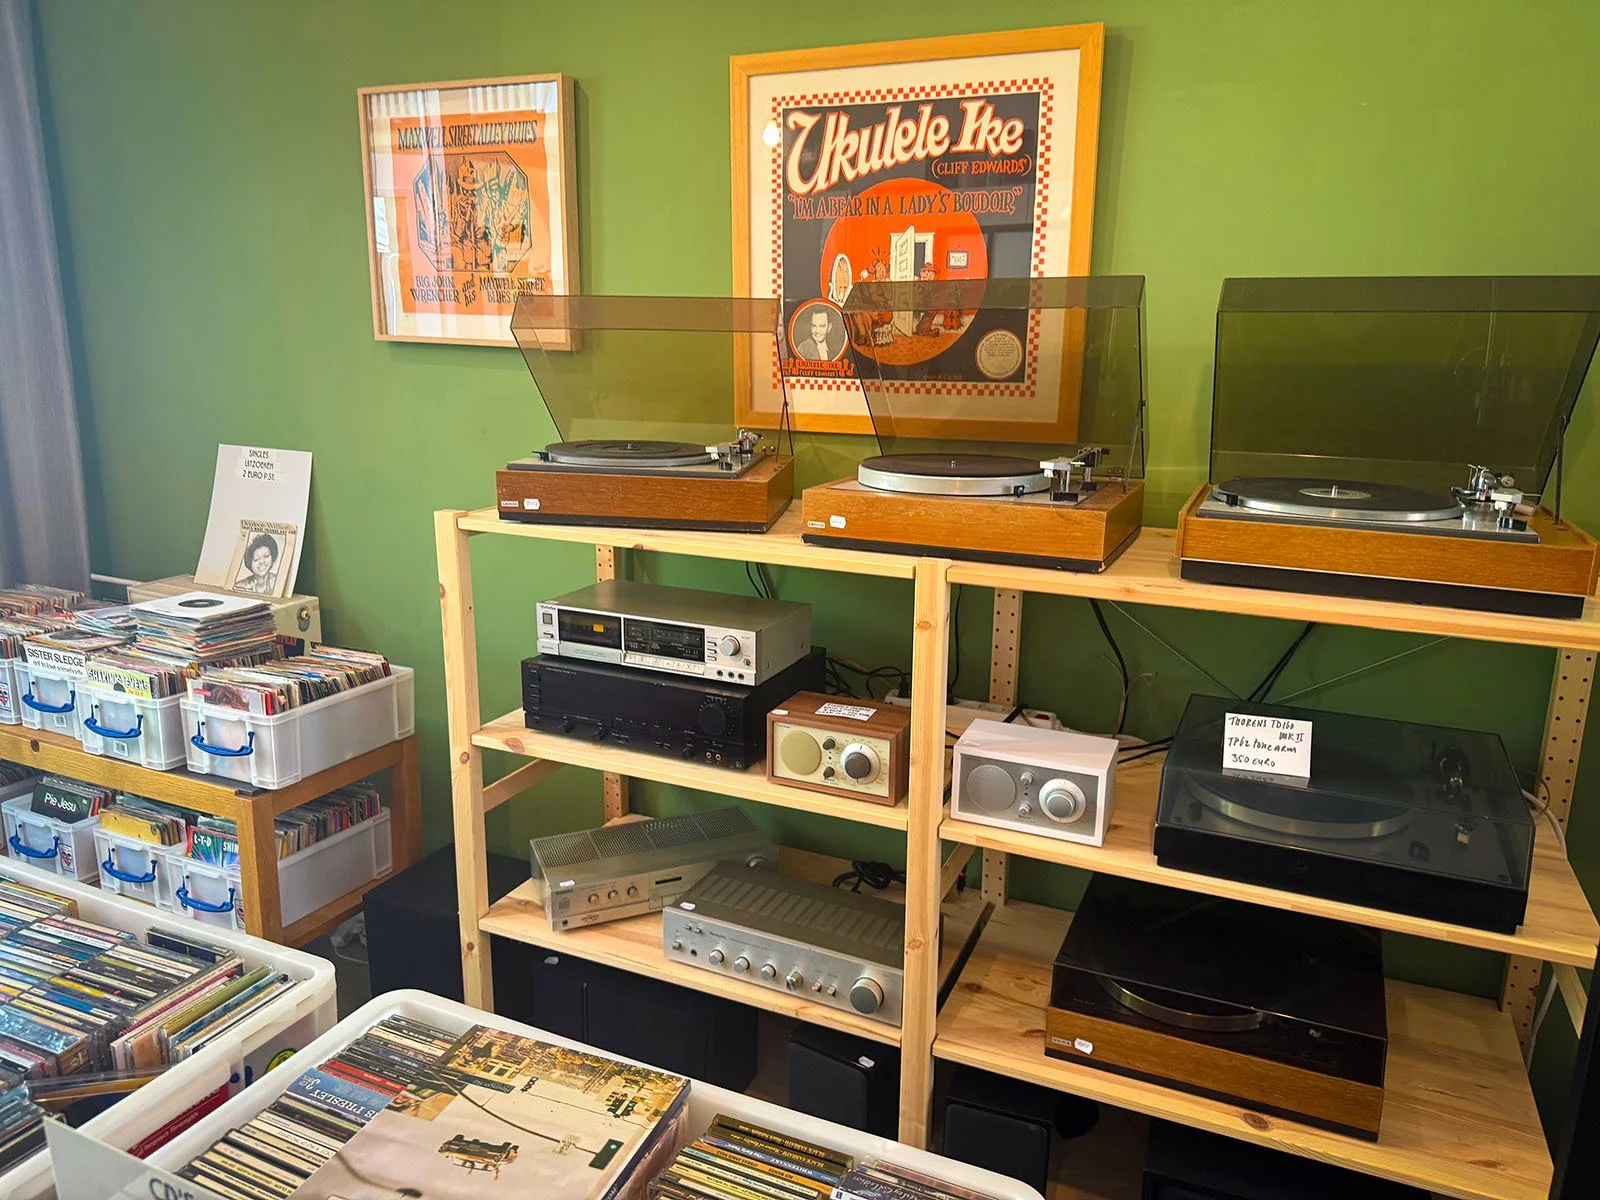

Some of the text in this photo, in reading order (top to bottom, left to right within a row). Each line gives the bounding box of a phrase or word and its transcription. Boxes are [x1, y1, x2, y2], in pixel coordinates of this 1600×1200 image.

[397, 120, 538, 151] MAXWELL STREET ALLEY BLUES
[786, 98, 1025, 196] Ukulele Ike
[931, 154, 1034, 180] (CLIFF EDWARDS)
[828, 194, 862, 218] BEAR
[865, 195, 881, 217] IN
[883, 194, 893, 216] A
[899, 190, 950, 216] LADY'S
[416, 275, 430, 288] BIG
[462, 273, 476, 293] and
[479, 276, 515, 292] MAXWELL
[410, 287, 461, 304] WRENCHER
[463, 289, 477, 308] his
[487, 290, 511, 305] BLUES
[248, 449, 270, 459] SINGLES
[242, 469, 247, 478] 2
[247, 470, 263, 480] EURO
[27, 647, 85, 668] SISTER SLEDGE
[1228, 715, 1295, 730] THORENS TD160
[1253, 738, 1272, 752] tone
[1231, 753, 1249, 764] 350
[44, 791, 77, 812] Pie Jesu
[305, 1077, 321, 1090] 3
[308, 1089, 366, 1115] PRESLEY
[771, 1157, 813, 1175] WHITESNAKE
[807, 1156, 825, 1168] BLACK
